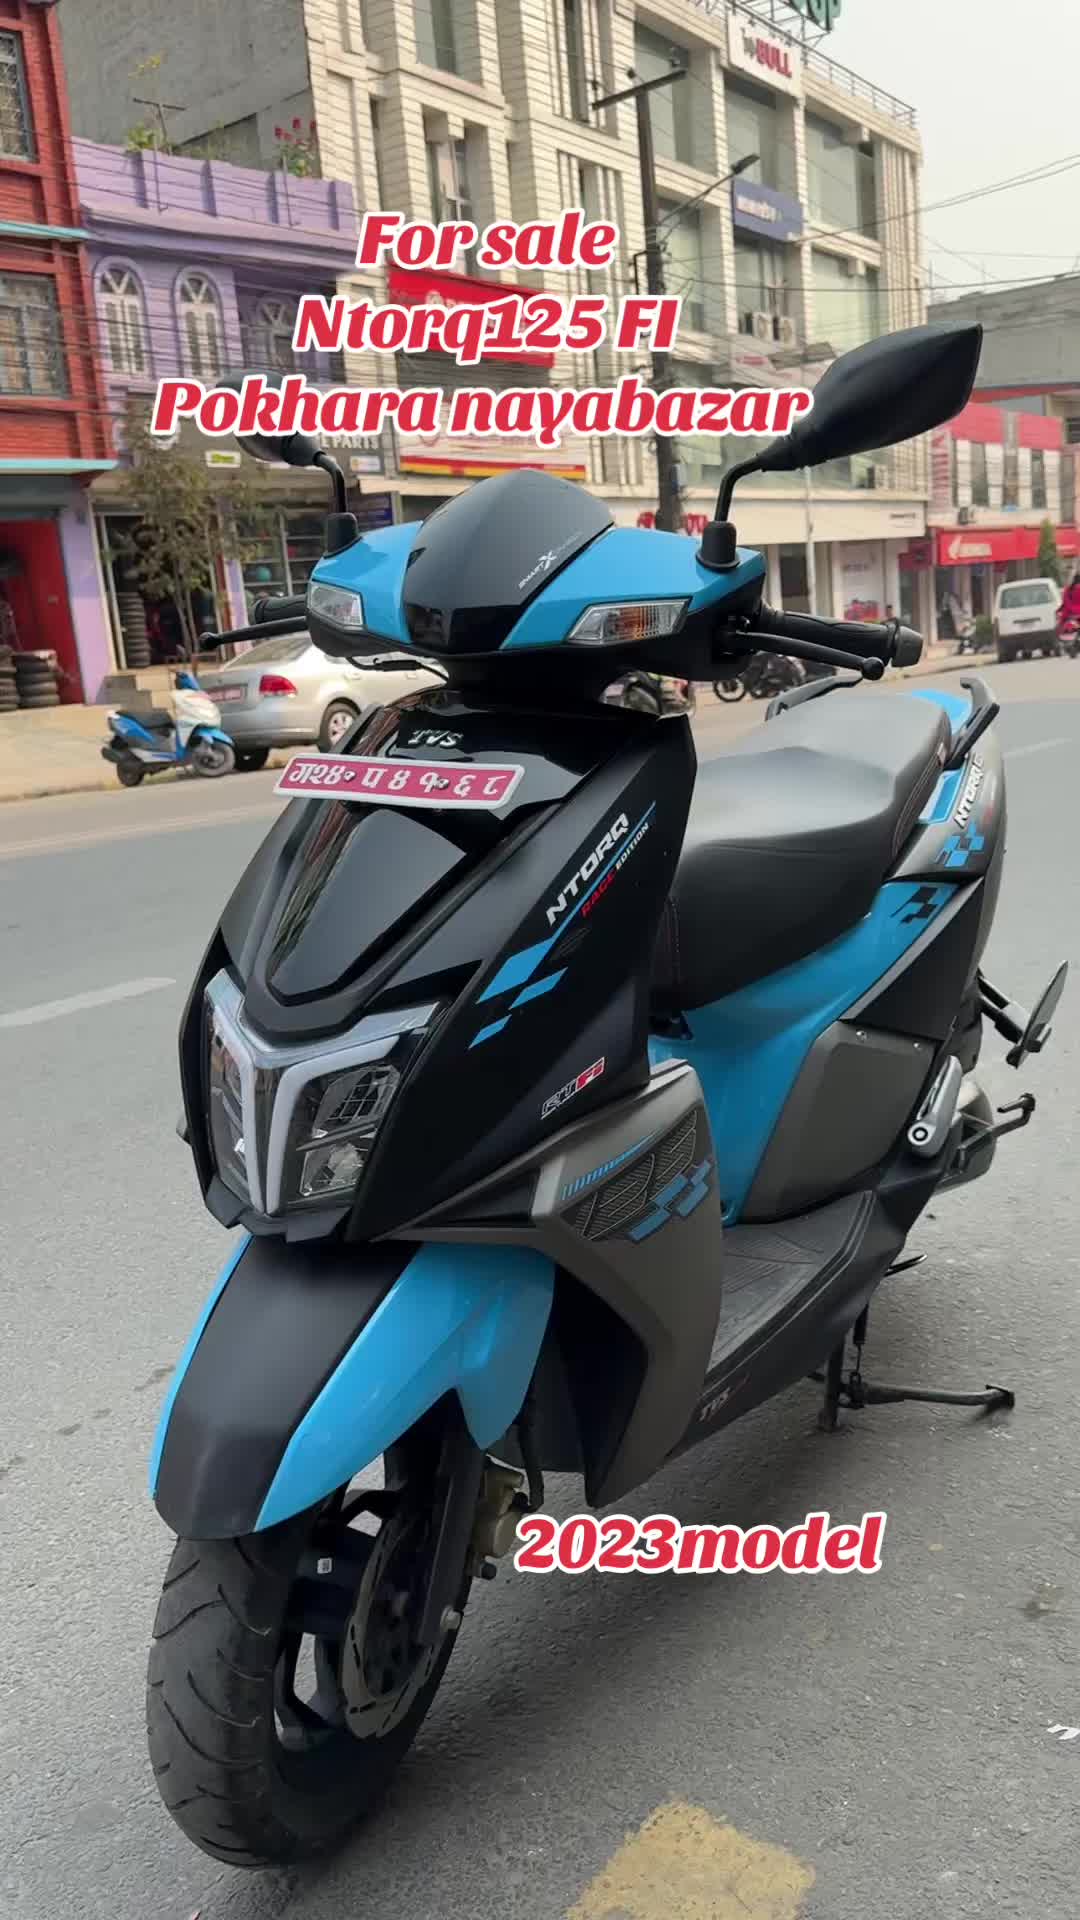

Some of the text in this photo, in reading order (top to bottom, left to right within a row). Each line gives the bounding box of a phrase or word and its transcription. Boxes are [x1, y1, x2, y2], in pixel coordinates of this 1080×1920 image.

[408, 729, 464, 748] TVS
[545, 812, 630, 926] NTORQ
[580, 822, 650, 919] RACE EDITION
